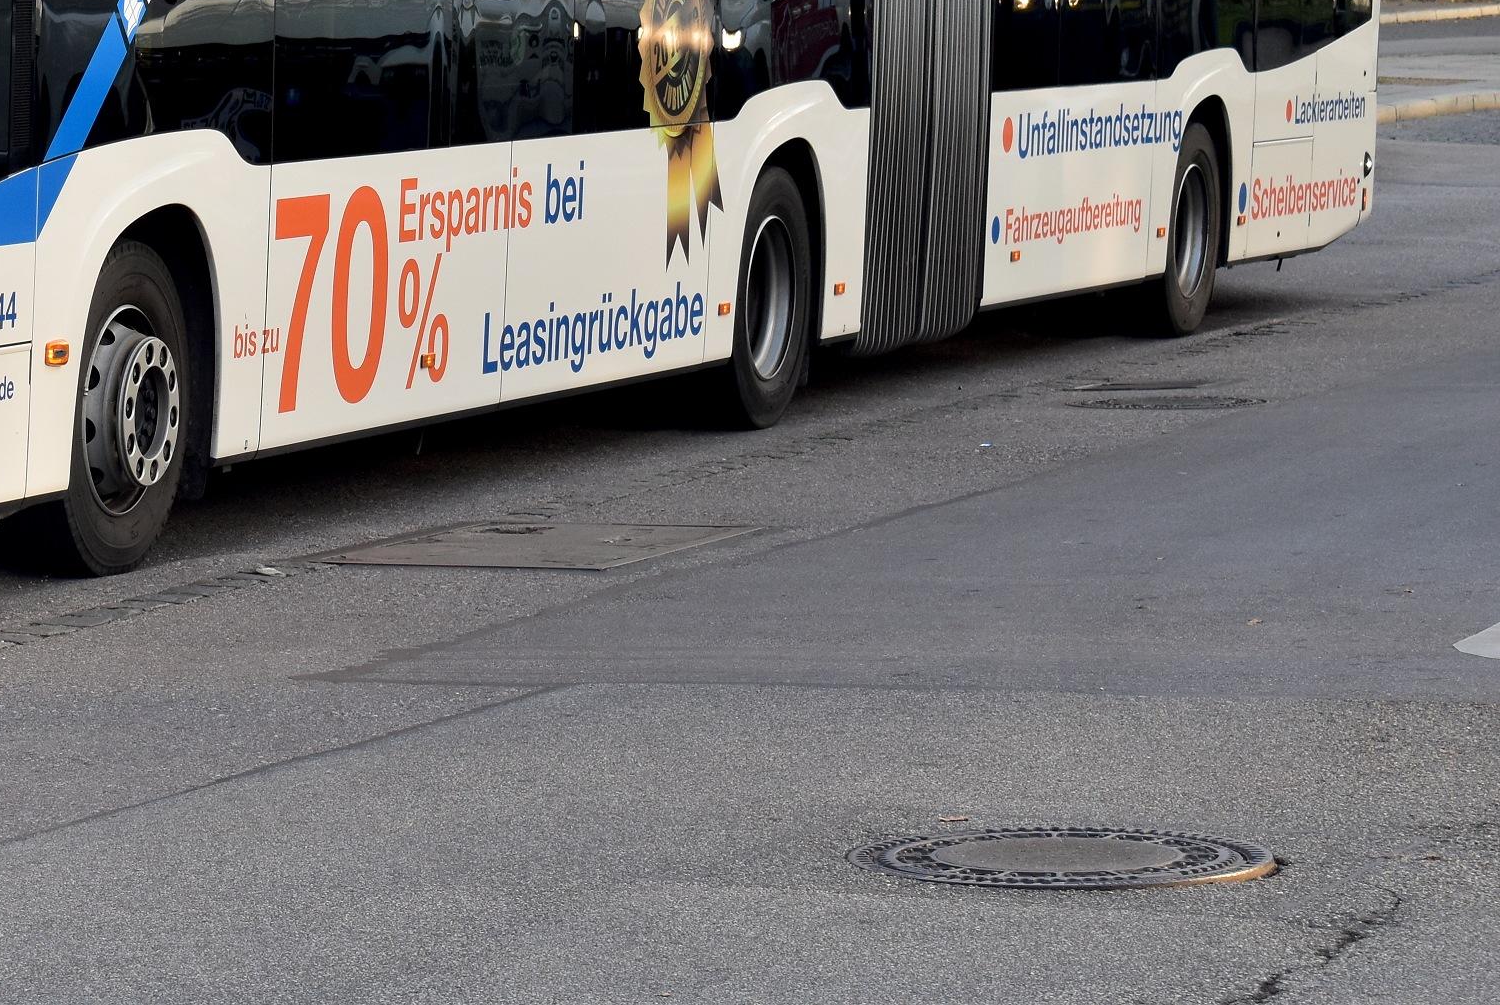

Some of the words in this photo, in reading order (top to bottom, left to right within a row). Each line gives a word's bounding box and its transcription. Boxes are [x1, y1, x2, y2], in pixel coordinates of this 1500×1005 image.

[1018, 102, 1182, 159] Unfallinstandsetzung
[1294, 91, 1366, 125] Lackierarbeiten
[398, 167, 532, 252] Ersparnis
[544, 159, 585, 225] bei
[1004, 192, 1142, 245] Fahrzeugaufbereitung
[1251, 169, 1357, 221] Scheibenservice
[233, 323, 257, 359] bis
[262, 326, 279, 355] zu
[482, 282, 704, 375] Leasingrückgabe
